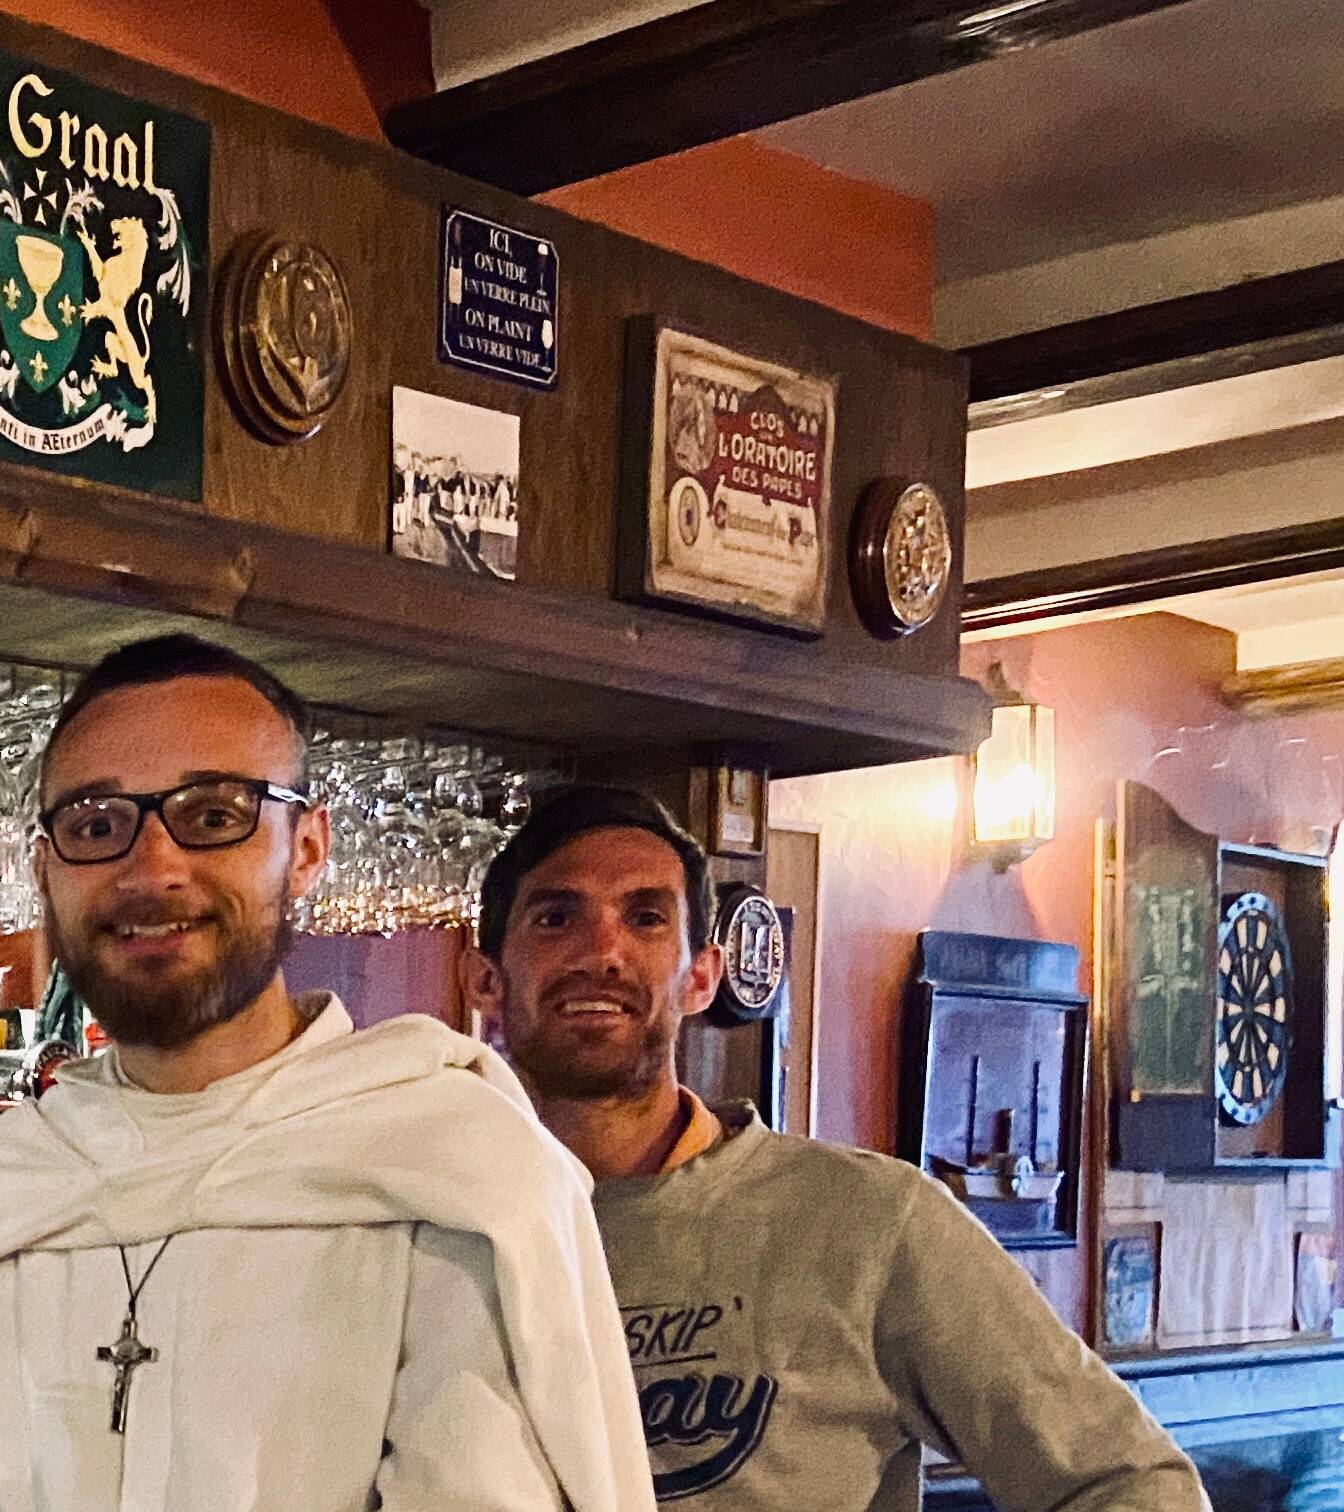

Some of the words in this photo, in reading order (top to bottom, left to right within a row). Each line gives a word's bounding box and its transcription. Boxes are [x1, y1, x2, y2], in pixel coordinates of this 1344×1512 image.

[8, 73, 156, 195] Graal
[474, 252, 495, 274] ON
[496, 257, 528, 285] VIDE
[480, 280, 518, 306] VERRE
[465, 307, 486, 329] ON
[487, 313, 533, 342] PLAINT
[459, 334, 475, 351] UN
[475, 336, 514, 362] VERRE
[750, 411, 785, 438] CLOS
[23, 432, 37, 447] in
[732, 465, 759, 488] DES
